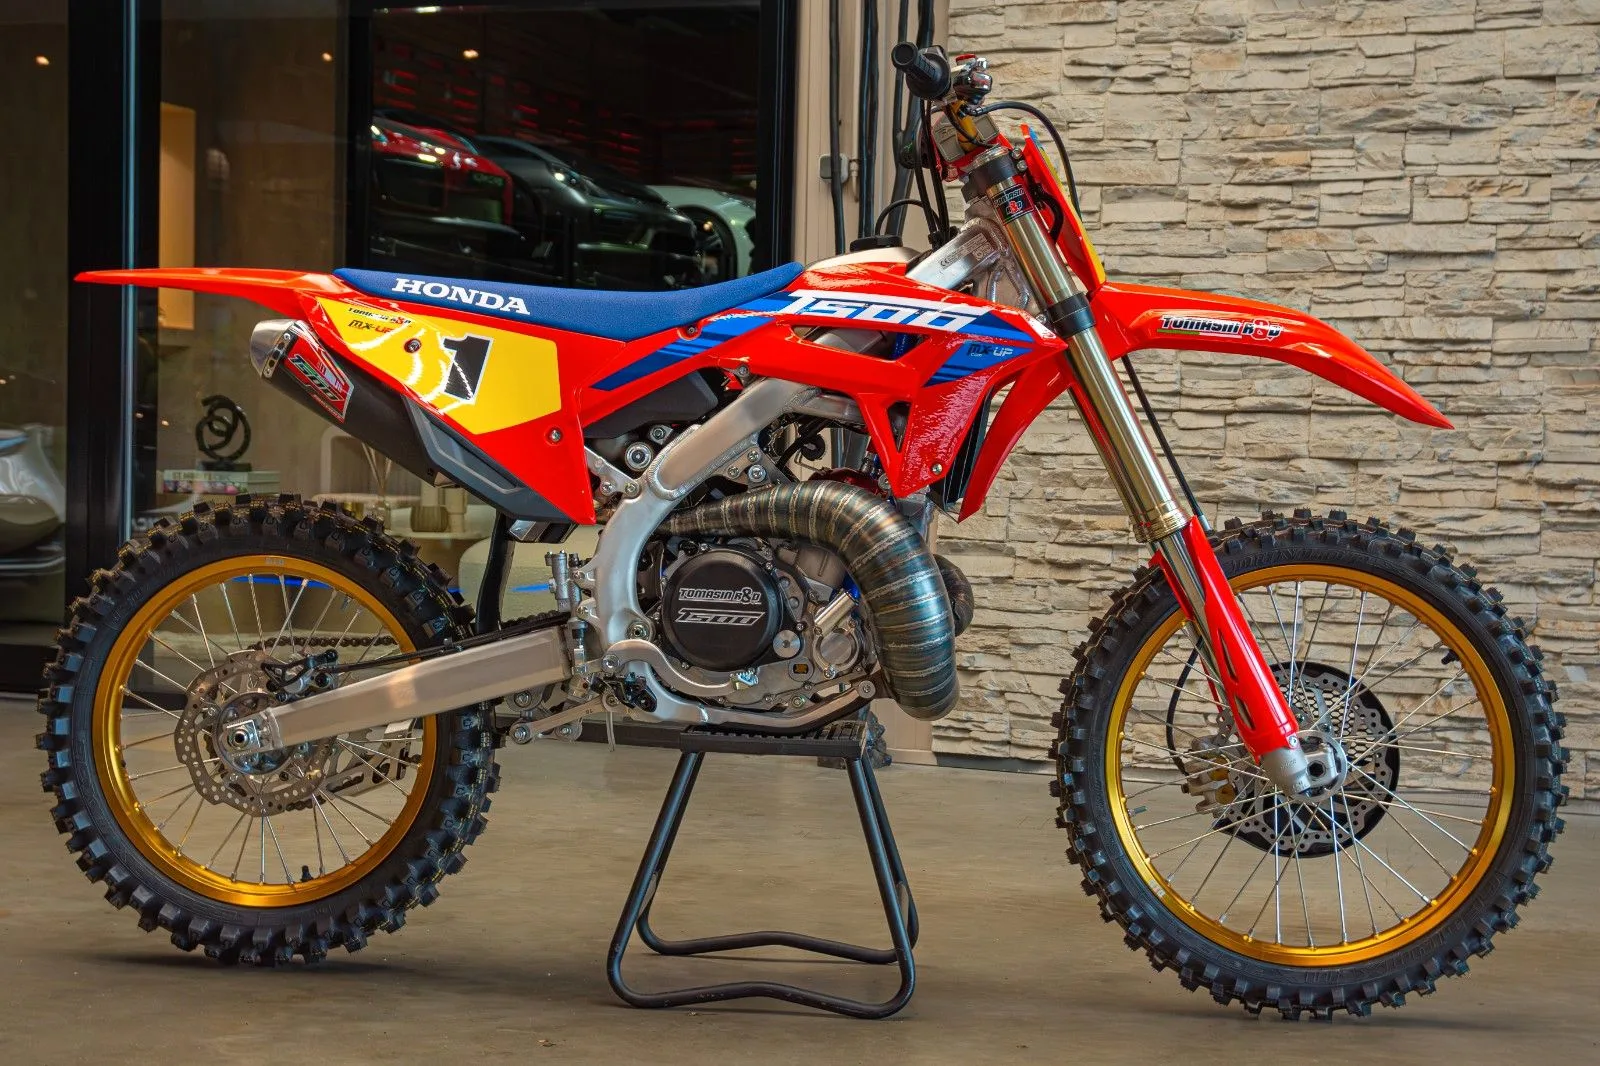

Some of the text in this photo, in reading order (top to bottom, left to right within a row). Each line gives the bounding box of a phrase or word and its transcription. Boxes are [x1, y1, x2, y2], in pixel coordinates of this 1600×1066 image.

[391, 278, 531, 315] HONDA
[441, 333, 493, 405] 1
[679, 586, 761, 604] TOMASIN R&D
